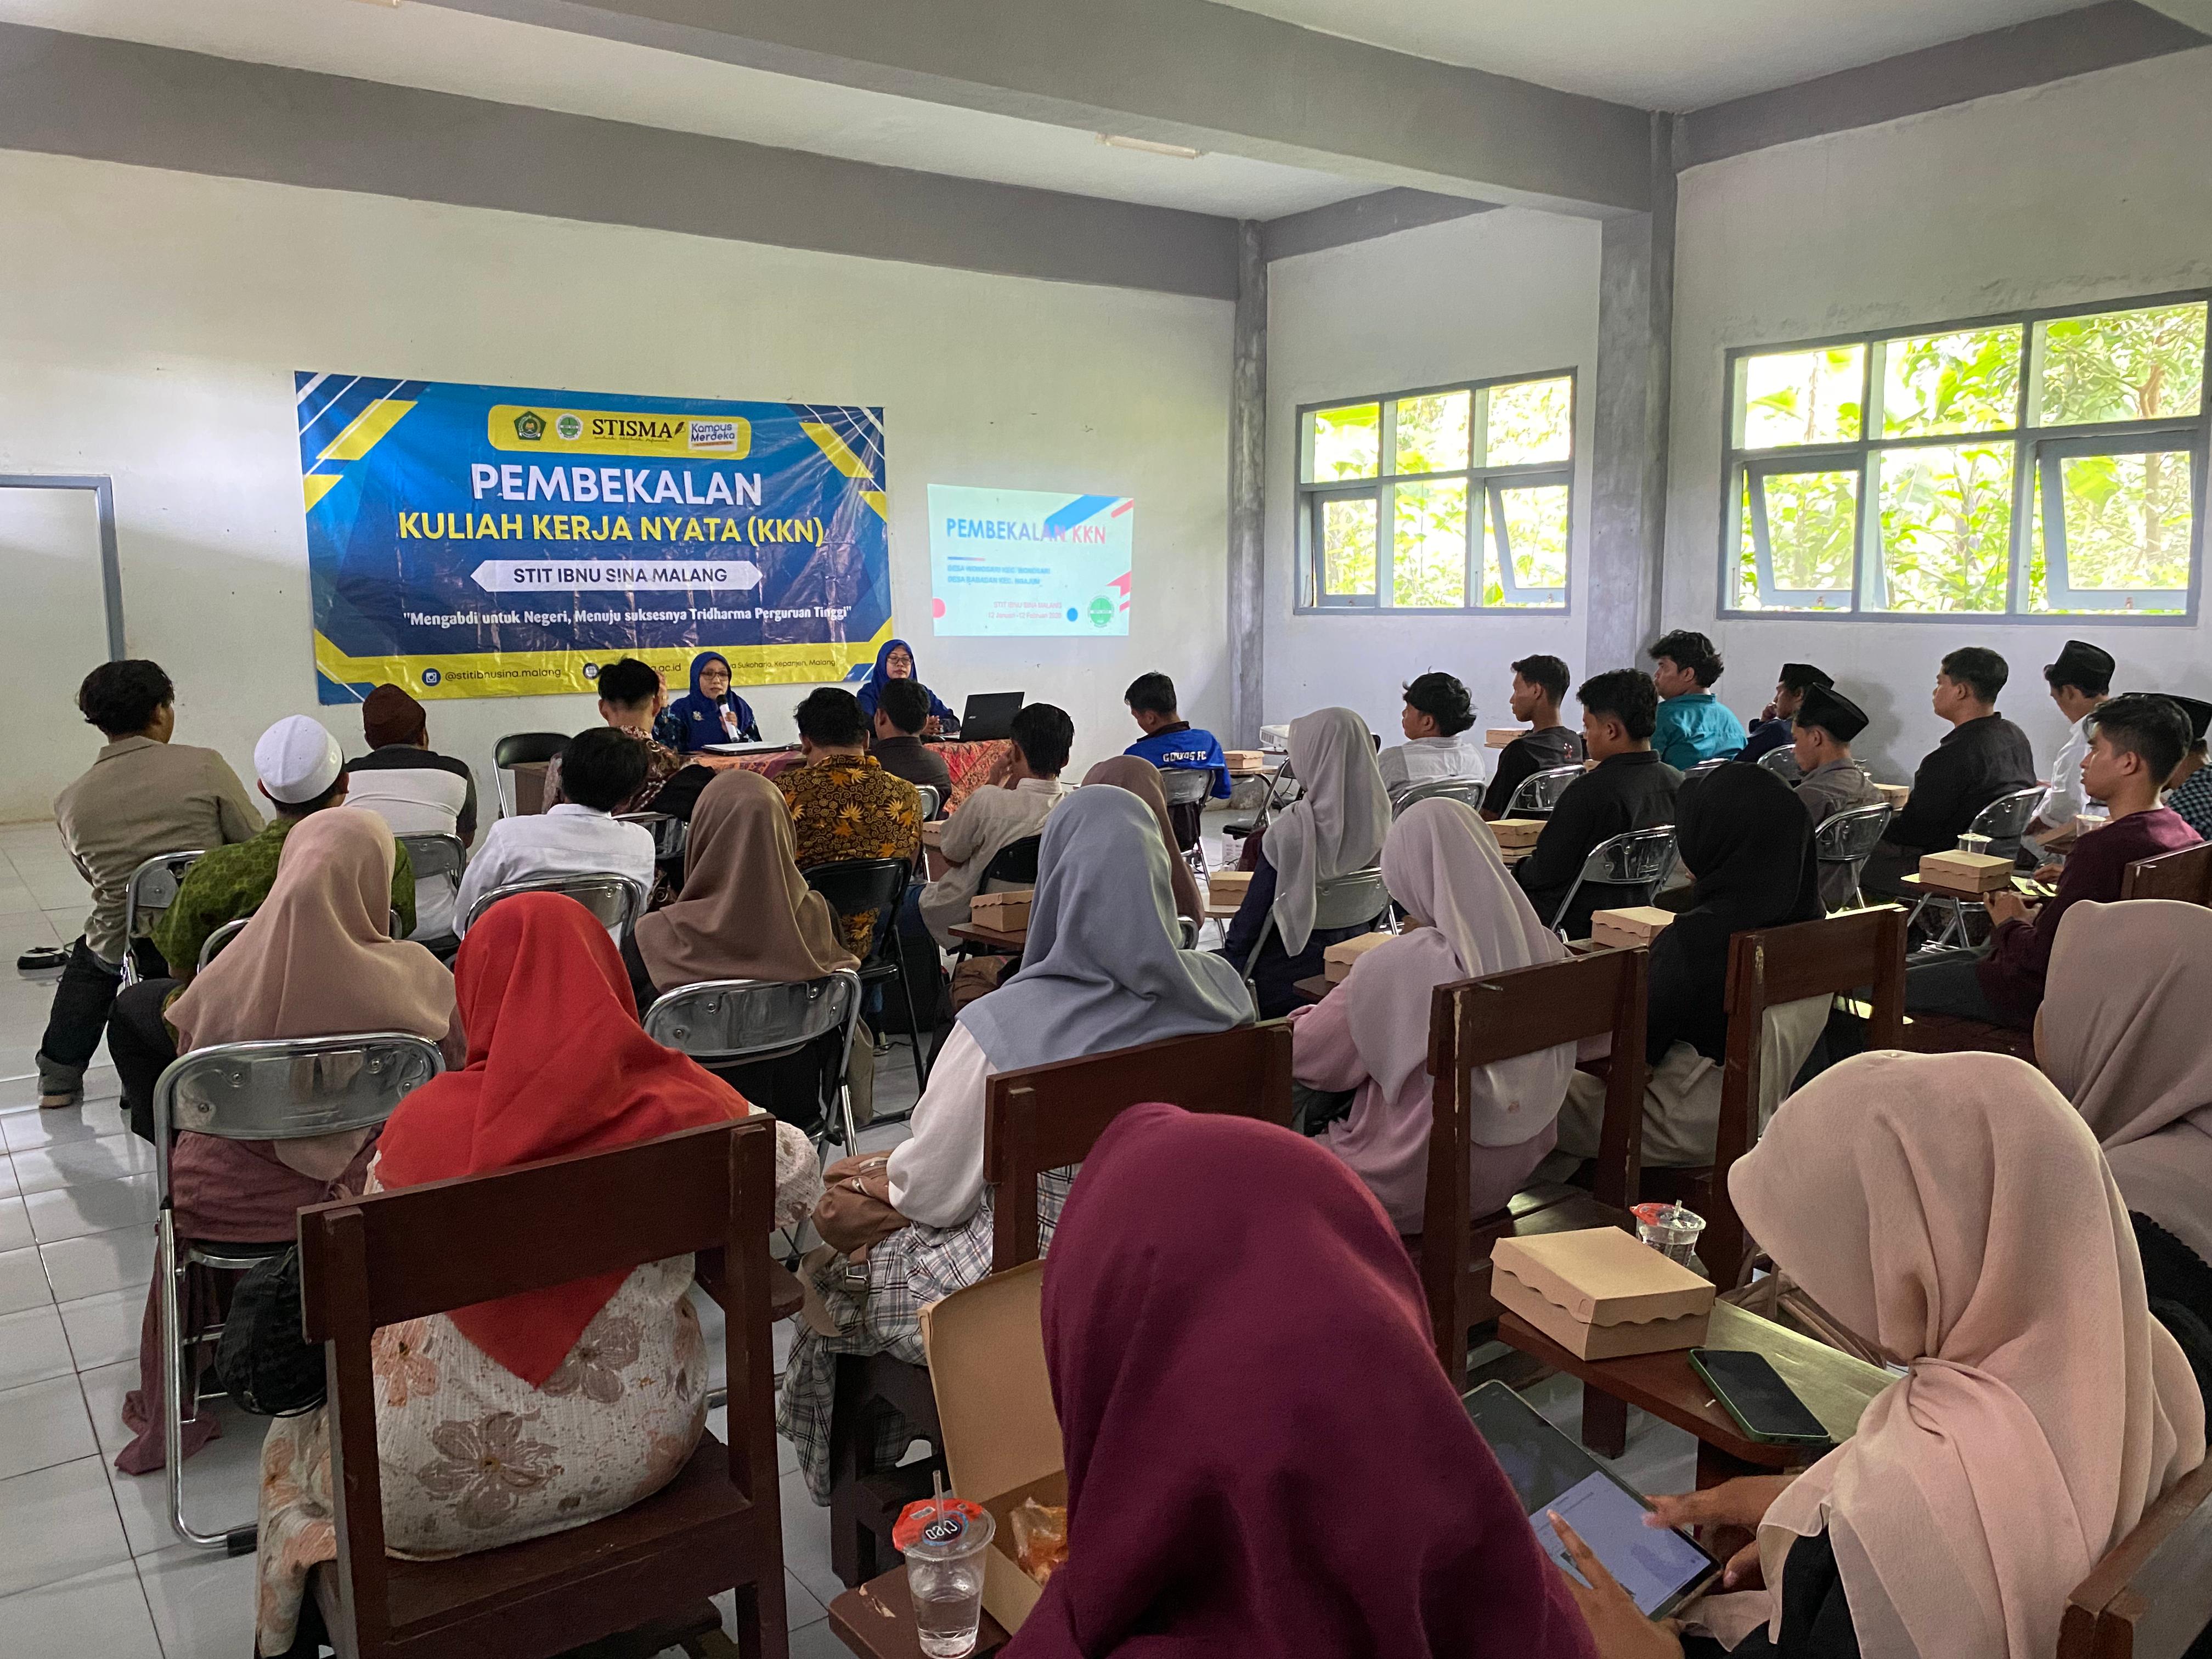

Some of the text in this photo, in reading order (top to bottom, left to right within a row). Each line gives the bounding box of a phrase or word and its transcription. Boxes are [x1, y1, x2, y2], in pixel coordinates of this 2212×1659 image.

[592, 419, 673, 438] STISMA
[691, 424, 732, 434] Kampus
[691, 431, 735, 442] Merdeka
[471, 463, 761, 506] PEMBEKALAN
[399, 512, 824, 547] KULIAH KERJA NYATA (KKN)
[946, 518, 1106, 544] PEMBEKALAN KKN
[514, 568, 727, 583] STIT IBNU SINA MALANG
[403, 606, 851, 628] "Mengabdi untuk Negeri, Menuju suksesnya Tridharma Perguruan Tinggi"
[445, 667, 561, 681] @stitibnusina.malang
[1197, 751, 1207, 760] FC
[926, 1519, 958, 1539] Cleo
